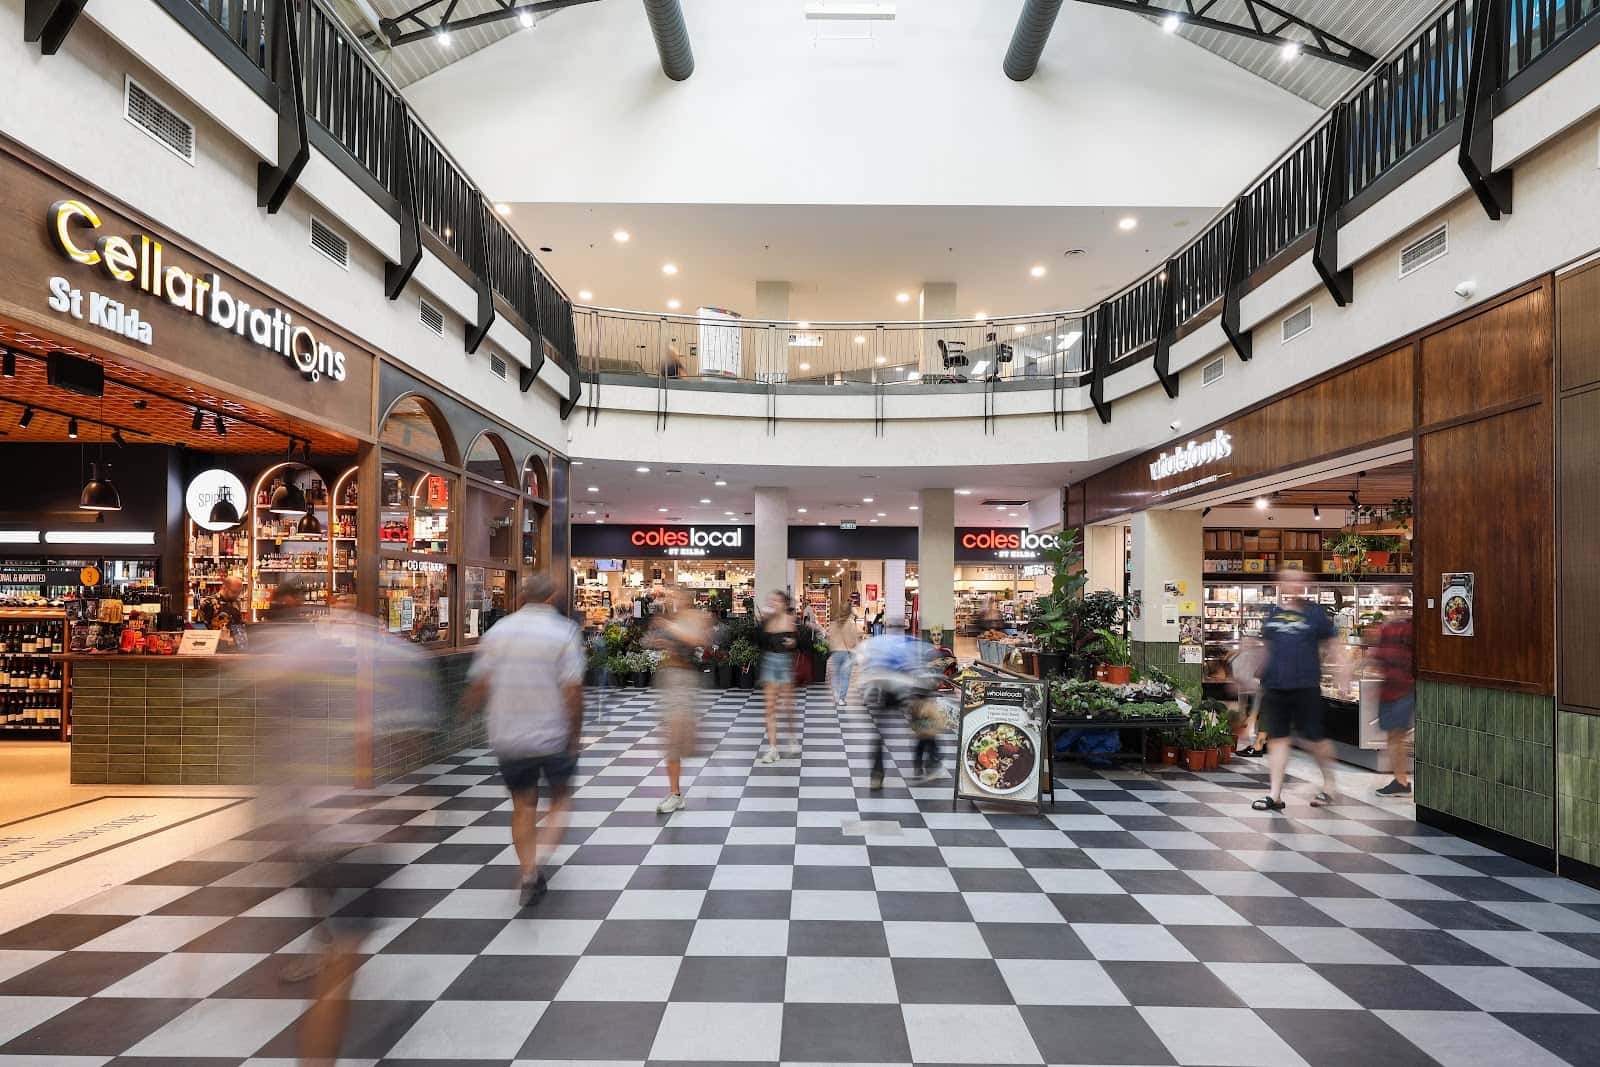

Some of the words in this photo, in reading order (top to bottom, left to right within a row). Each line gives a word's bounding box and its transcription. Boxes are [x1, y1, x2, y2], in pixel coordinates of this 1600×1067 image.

[49, 200, 346, 382] Cellarbrations
[48, 276, 83, 320] St
[88, 291, 153, 345] Kilda
[631, 527, 689, 546] coles
[690, 527, 742, 547] local
[963, 529, 1020, 549] coles
[19, 573, 46, 583] IMPORTED
